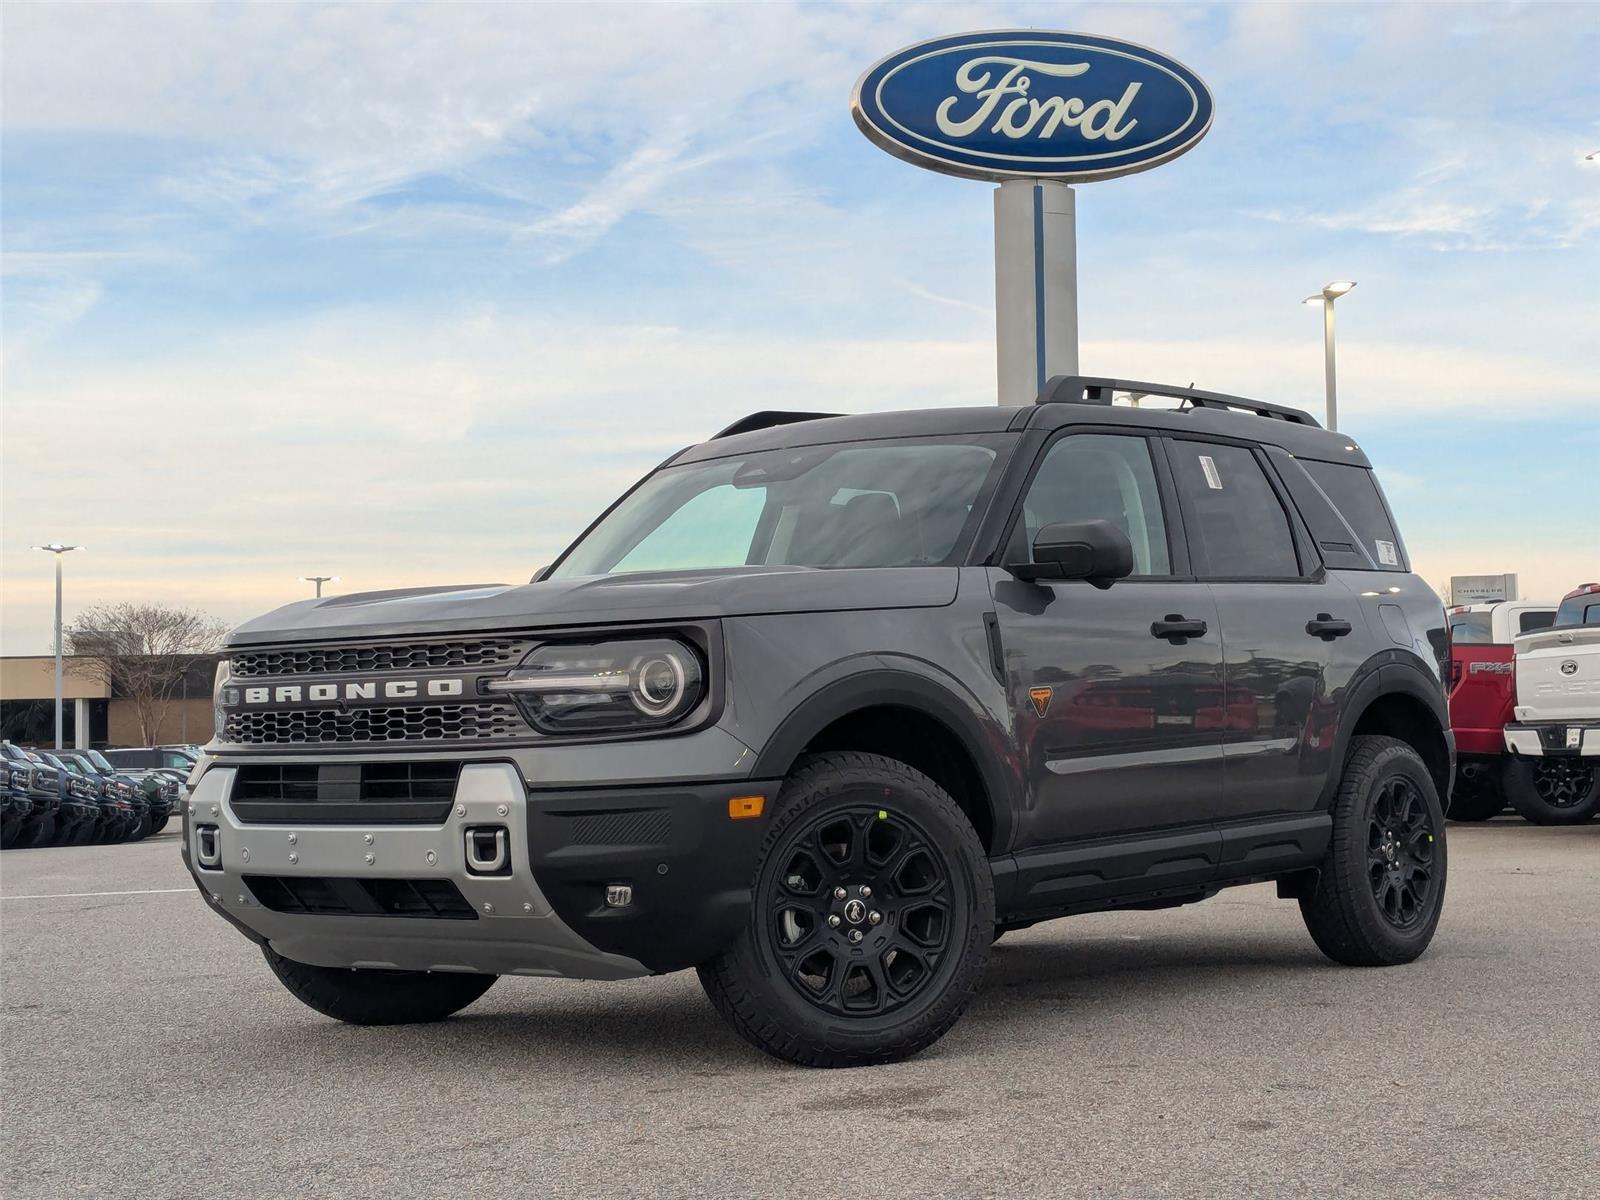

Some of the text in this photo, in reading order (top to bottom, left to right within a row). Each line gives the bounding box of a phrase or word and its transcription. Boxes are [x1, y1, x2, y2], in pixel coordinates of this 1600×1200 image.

[935, 56, 1143, 141] Ford
[1470, 661, 1513, 674] FX4
[245, 679, 463, 704] BRONCO
